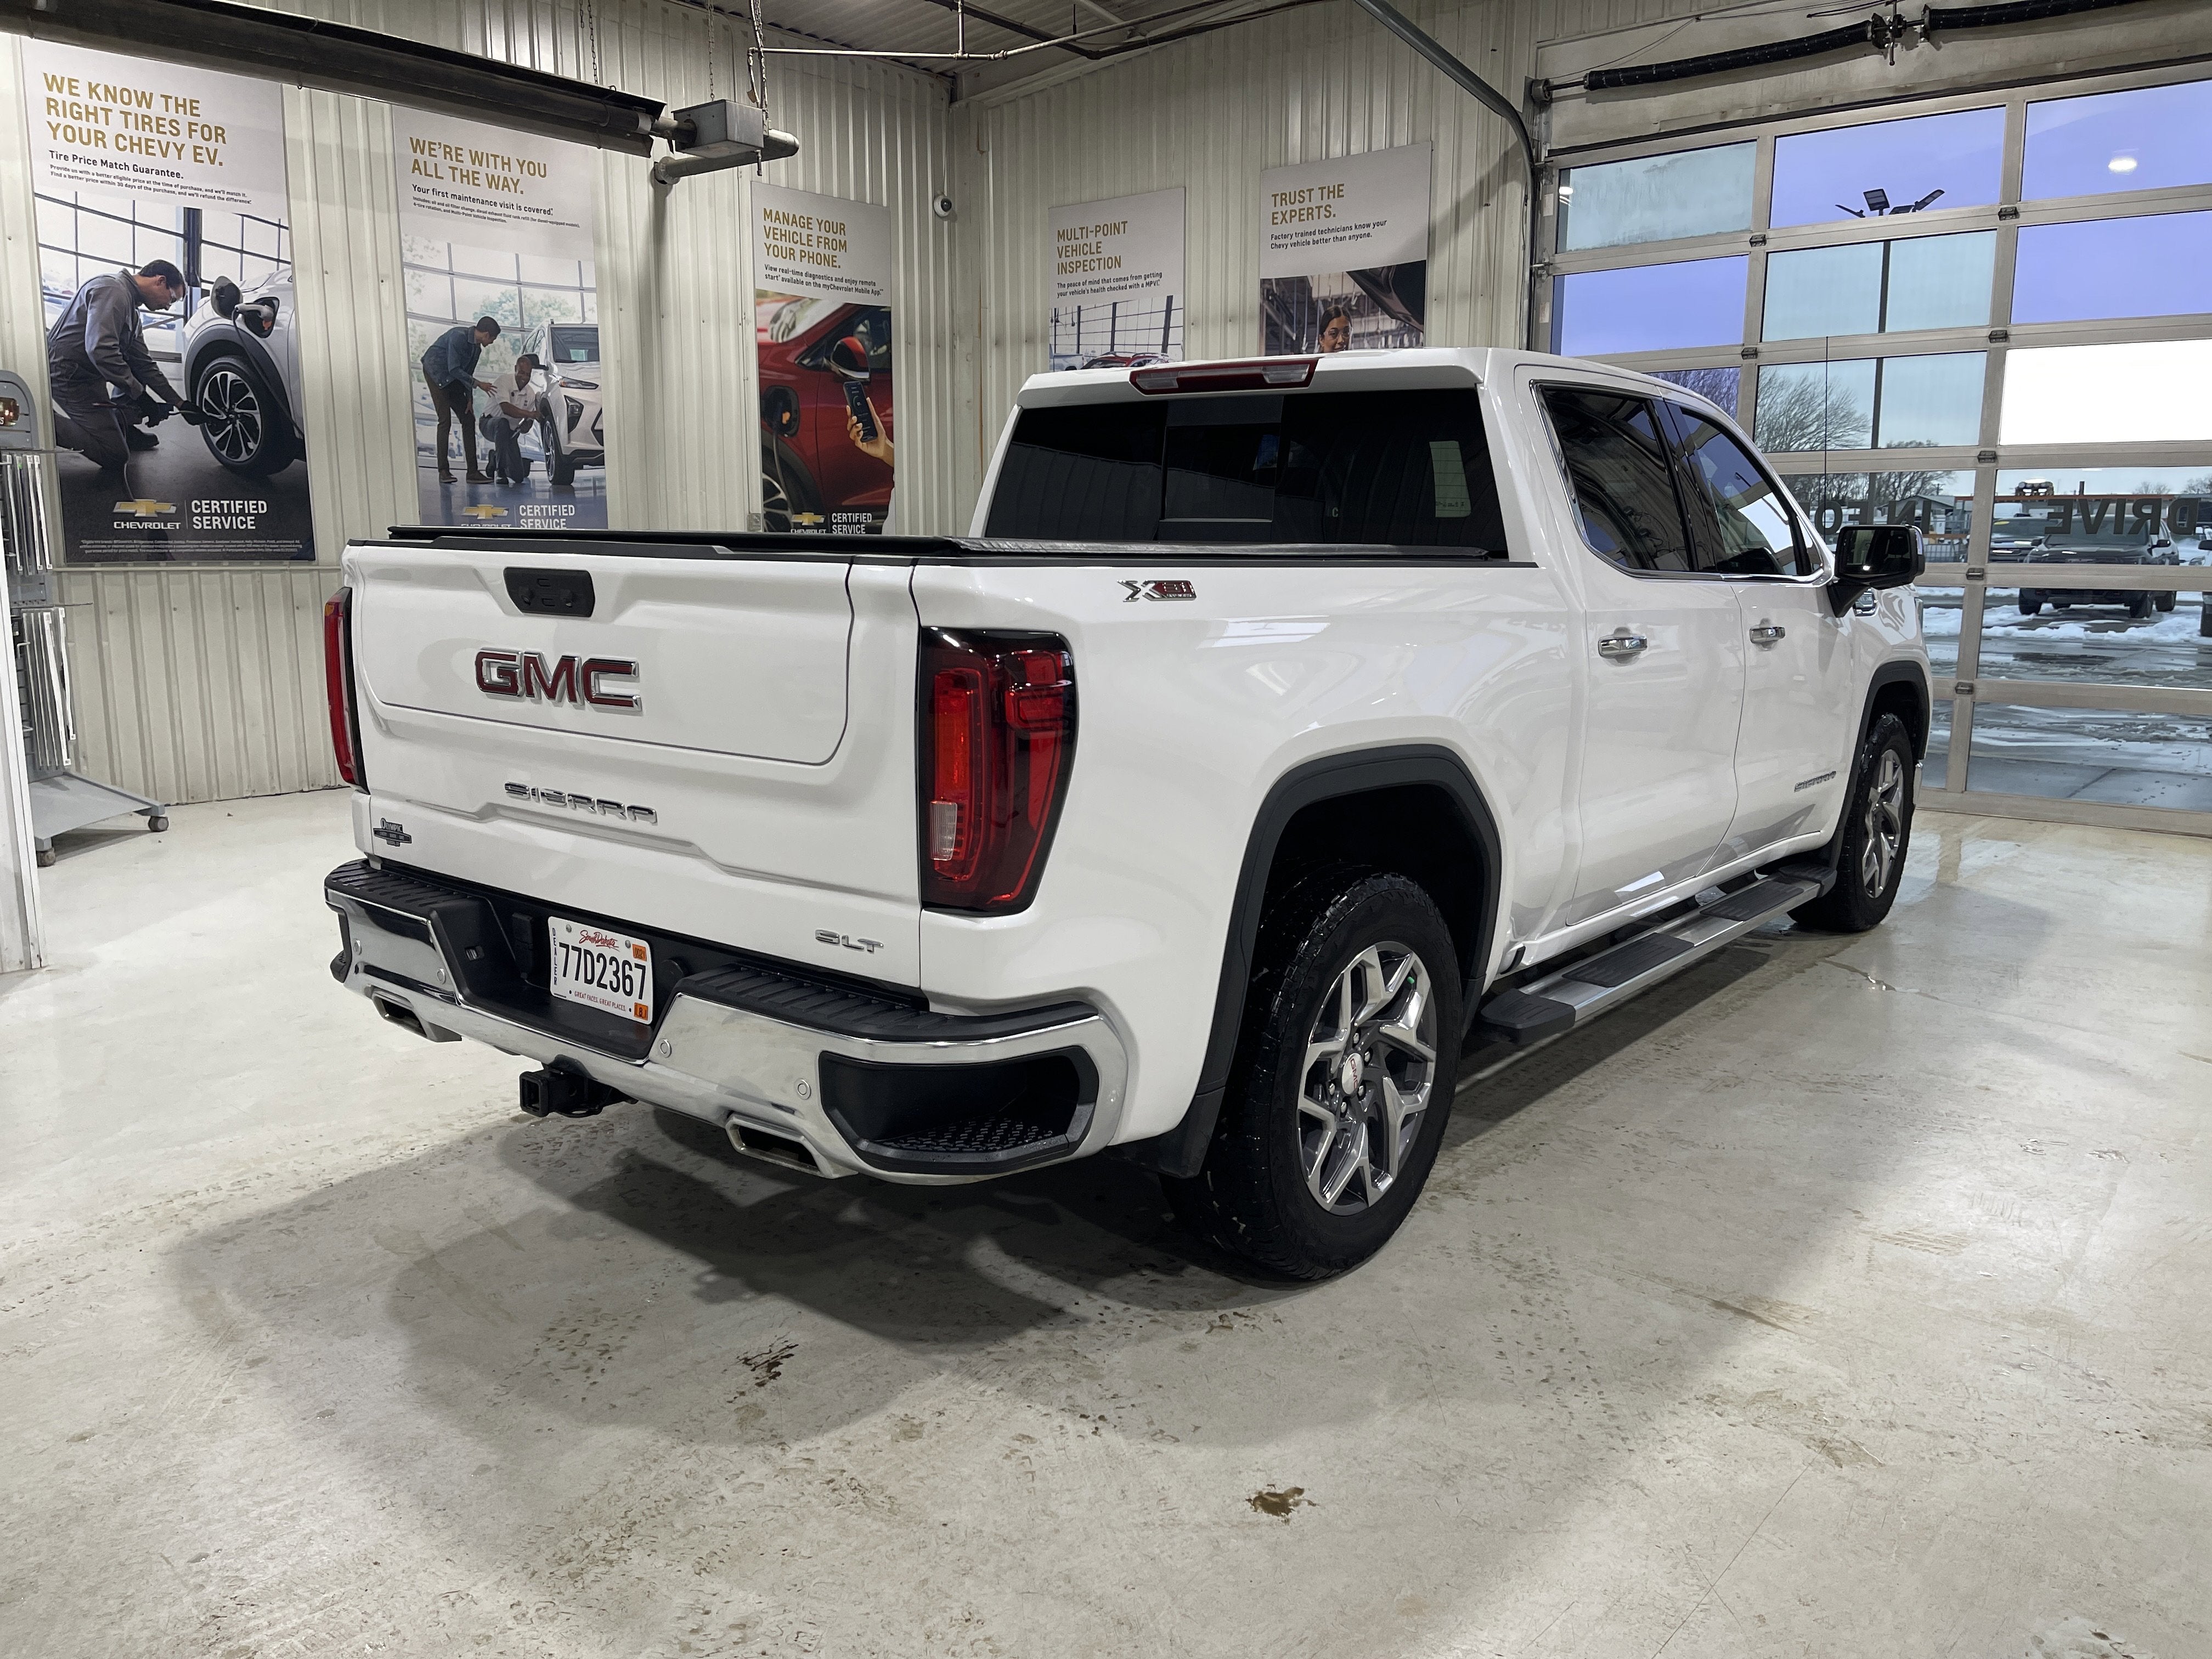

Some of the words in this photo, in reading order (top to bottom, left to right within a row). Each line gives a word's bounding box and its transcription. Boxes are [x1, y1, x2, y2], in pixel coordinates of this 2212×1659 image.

[44, 73, 80, 96] WE
[88, 82, 153, 109] KNOW
[160, 94, 201, 117] THE
[46, 98, 112, 125] RIGHT
[119, 111, 180, 136] TIRES
[187, 122, 227, 144] FOR
[47, 122, 107, 148] YOUR
[115, 134, 185, 159] CHEVY
[193, 145, 223, 166] EV.
[49, 150, 69, 161] Tire
[72, 154, 97, 166] Price
[100, 159, 129, 171] Match
[132, 164, 183, 178] Guarantee.
[409, 137, 464, 162] WE'RE
[469, 149, 511, 171] WITH
[516, 159, 546, 177] YOU
[411, 159, 444, 179] ALL
[448, 166, 481, 186] THE
[485, 173, 523, 194] WAY.
[411, 184, 430, 194] Your
[431, 188, 448, 198] first
[450, 194, 497, 206] maintenance
[499, 201, 514, 210] visit
[1271, 188, 1314, 207] TRUST
[1318, 183, 1345, 201] THE
[763, 208, 813, 229] MANAGE
[816, 218, 846, 235] YOUR
[1271, 204, 1336, 225] EXPERTS.
[764, 226, 813, 246] VEHICLE
[816, 235, 847, 253] FROM
[1057, 221, 1128, 242] MULTI-POINT
[1289, 239, 1310, 247] vehicle
[1348, 232, 1372, 241] anyone.
[1295, 229, 1316, 238] trained
[1318, 225, 1352, 234] technicians
[1372, 220, 1387, 229] your
[765, 243, 795, 261] YOUR
[799, 250, 841, 268] PHONE.
[1057, 241, 1102, 258] VEHICLE
[1057, 255, 1121, 275] INSPECTION
[778, 268, 803, 276] real-time
[804, 271, 833, 281] diagnostics
[844, 277, 857, 286] enjoy
[1143, 272, 1162, 280] getting
[191, 500, 268, 514] CERTIFIED
[519, 505, 575, 517] CERTIFIED
[832, 512, 872, 523] CERTIFIED
[113, 521, 181, 530] CHEVROLET
[192, 516, 256, 530] SERVICE
[520, 518, 567, 529] SERVICE
[832, 524, 866, 534] SERVICE
[475, 647, 642, 713] GMC
[504, 781, 658, 824] SIERRA
[815, 929, 884, 953] SLT
[558, 942, 646, 1000] 77D2367
[574, 991, 586, 999] GREAT
[599, 998, 611, 1007] GREAT
